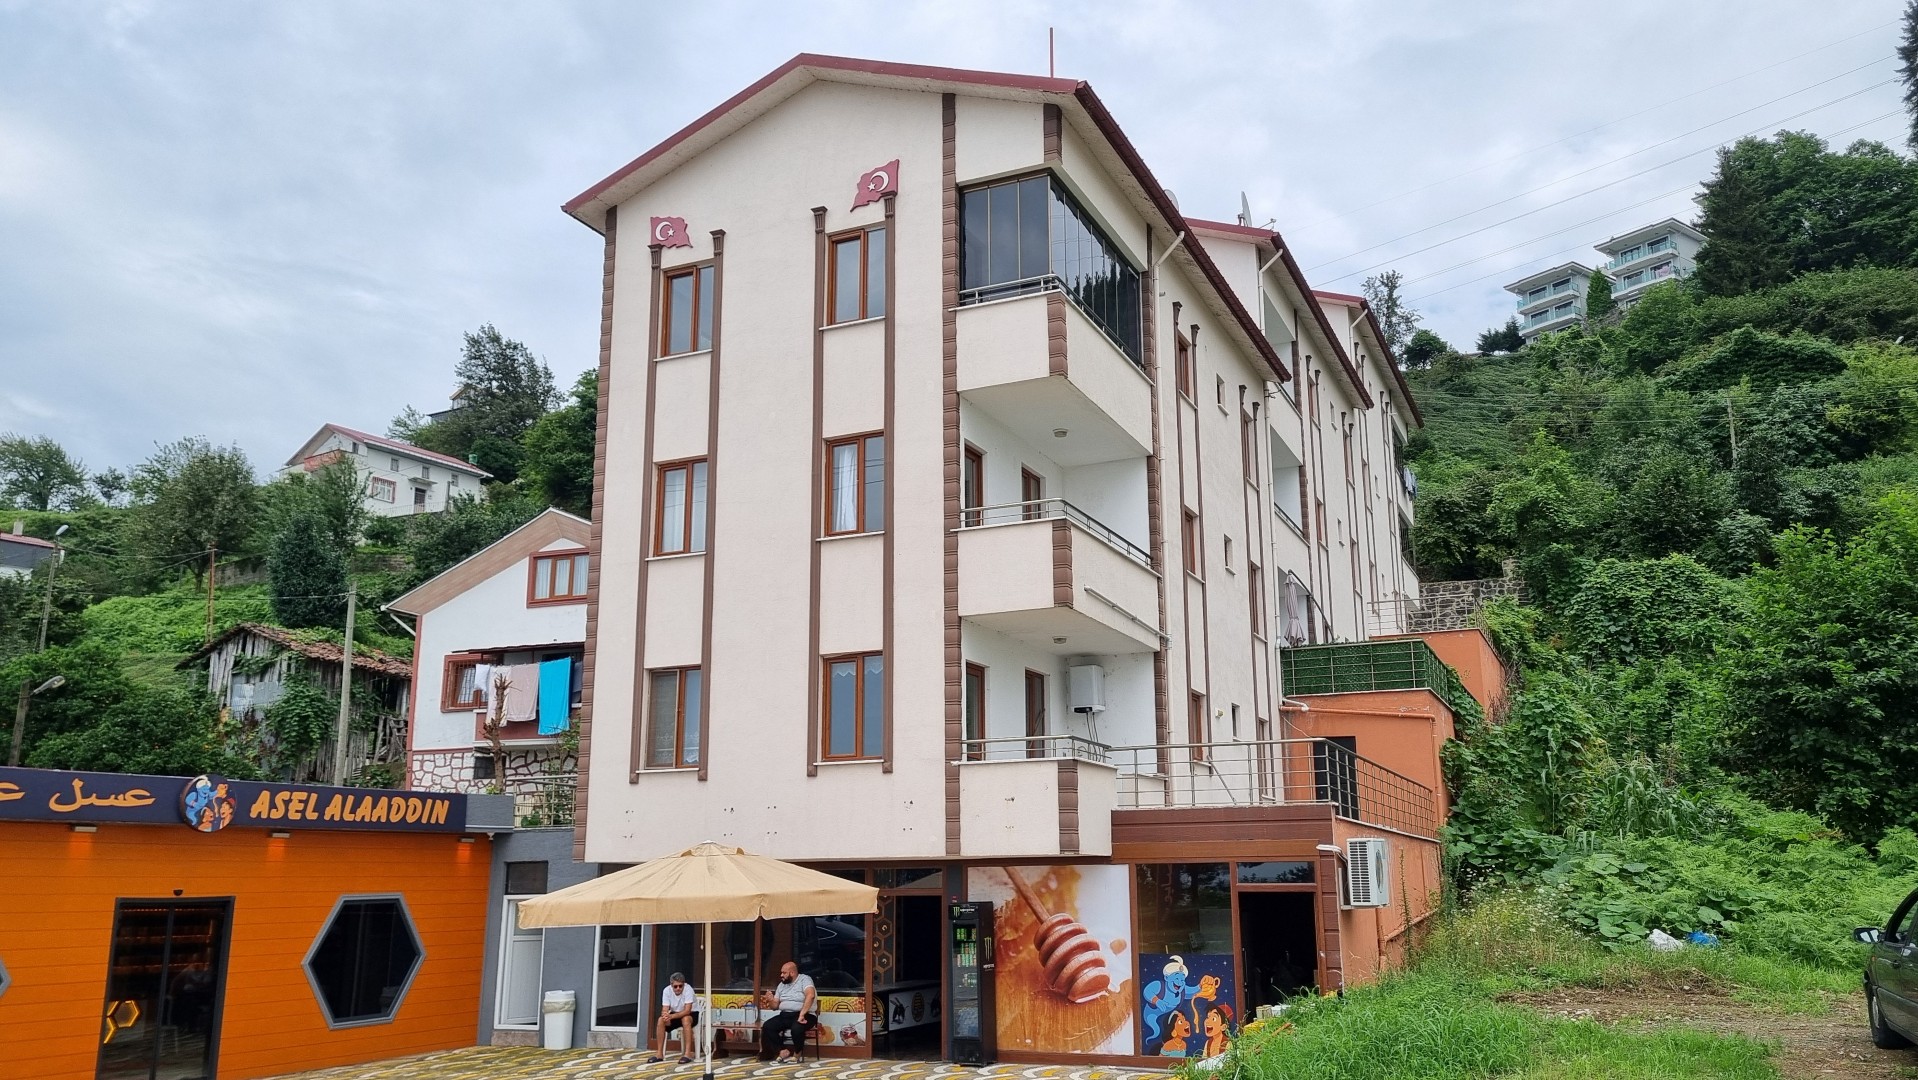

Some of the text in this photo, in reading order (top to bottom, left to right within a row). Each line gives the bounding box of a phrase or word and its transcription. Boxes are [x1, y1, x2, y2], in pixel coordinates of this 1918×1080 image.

[48, 778, 156, 812] عسل
[250, 790, 450, 825] ASEL ALAADDIN
